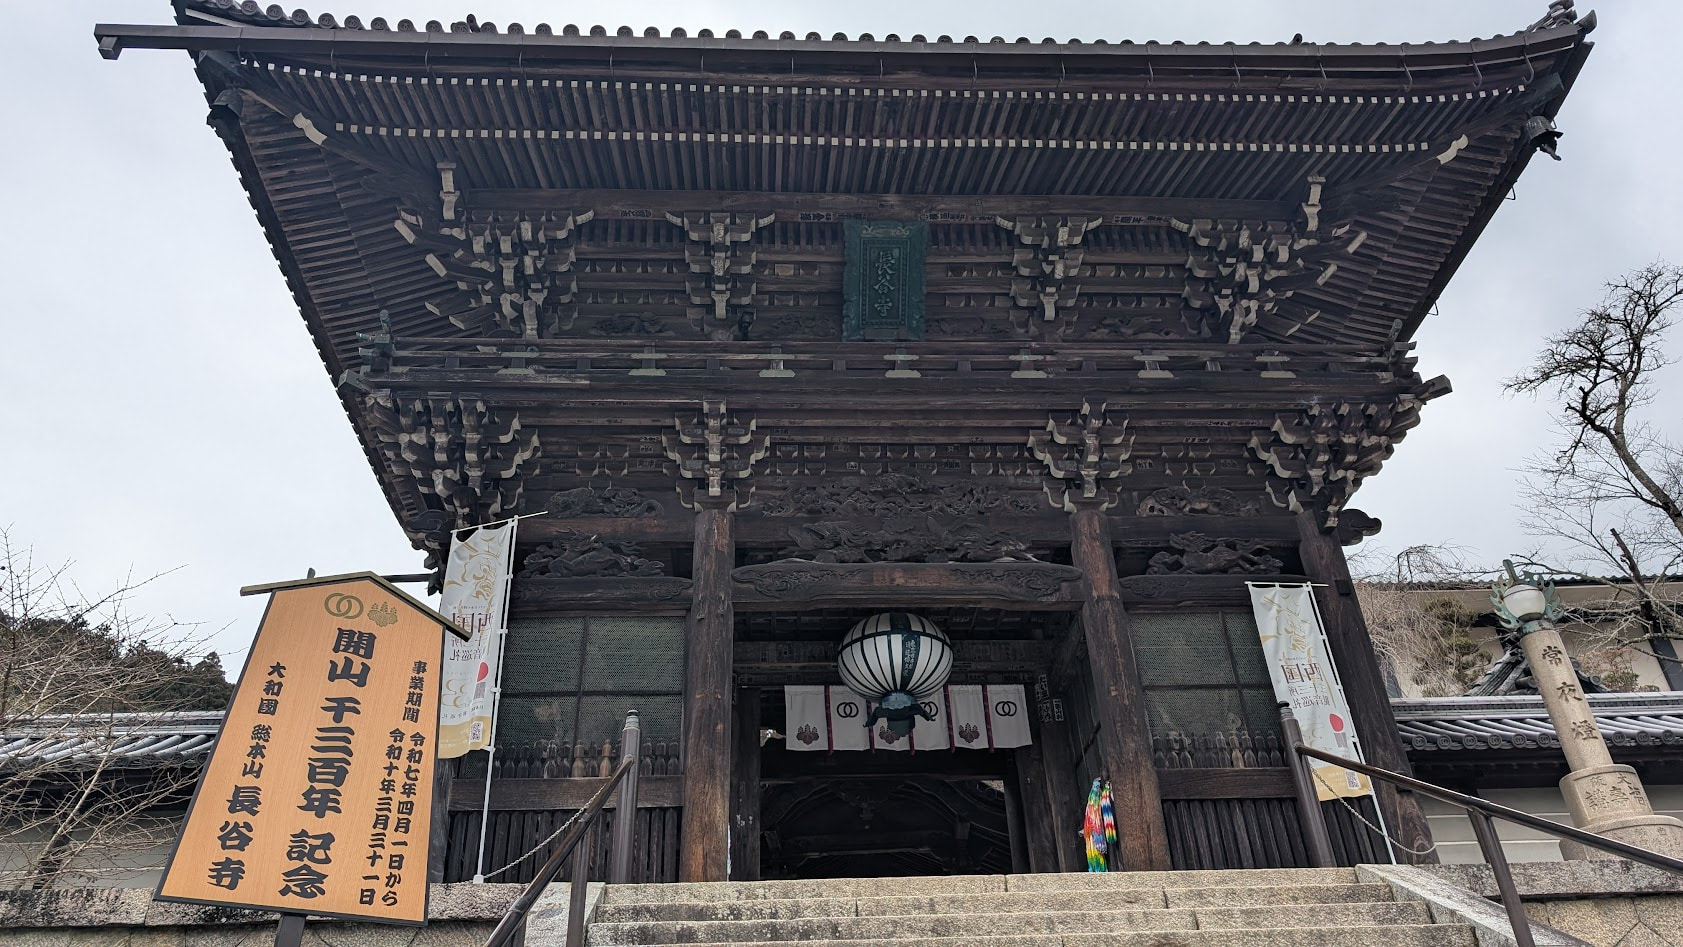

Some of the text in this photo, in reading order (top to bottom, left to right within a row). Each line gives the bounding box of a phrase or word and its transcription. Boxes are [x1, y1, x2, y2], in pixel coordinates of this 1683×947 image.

[873, 251, 896, 317] 長谷寺
[1541, 645, 1599, 741] 常夜燈
[359, 727, 406, 906] 令和十年三月三十一日
